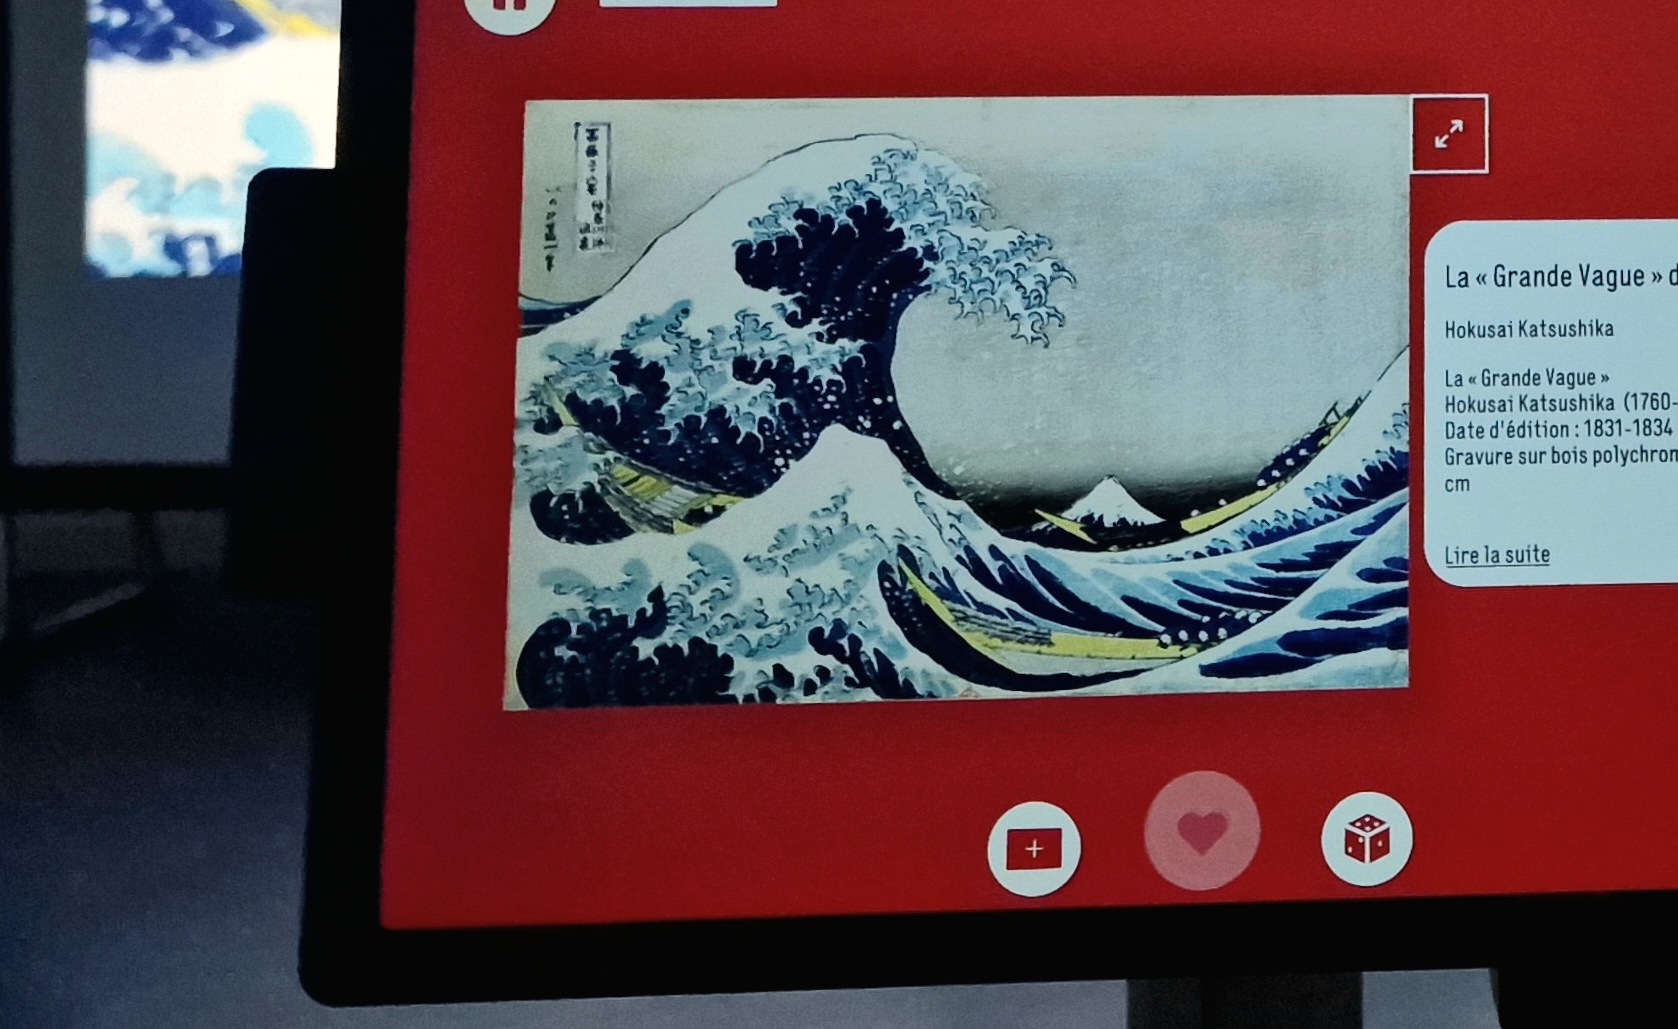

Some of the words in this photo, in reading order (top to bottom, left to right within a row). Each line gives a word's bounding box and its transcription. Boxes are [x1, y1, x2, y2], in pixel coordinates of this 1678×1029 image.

[1446, 264, 1470, 289] La
[1493, 263, 1572, 288] Grande
[1578, 263, 1645, 293] Vague
[1445, 320, 1513, 339] Hokusai
[1518, 318, 1615, 338] Katsushika
[1445, 369, 1464, 388] La
[1481, 368, 1541, 387] Grande
[1545, 367, 1596, 390] Vague
[1445, 395, 1513, 414] Hokusai
[1519, 392, 1615, 413] Katsushika
[1445, 421, 1485, 440] Date
[1489, 419, 1570, 439] d'édition
[1583, 418, 1674, 437] 1831-1834
[1445, 447, 1513, 466] Gravure
[1518, 450, 1547, 466] sur
[1551, 445, 1588, 465] bois
[1445, 478, 1470, 493] cm
[1445, 546, 1479, 565] Lire
[1484, 545, 1500, 564] la
[1505, 544, 1551, 564] suite
